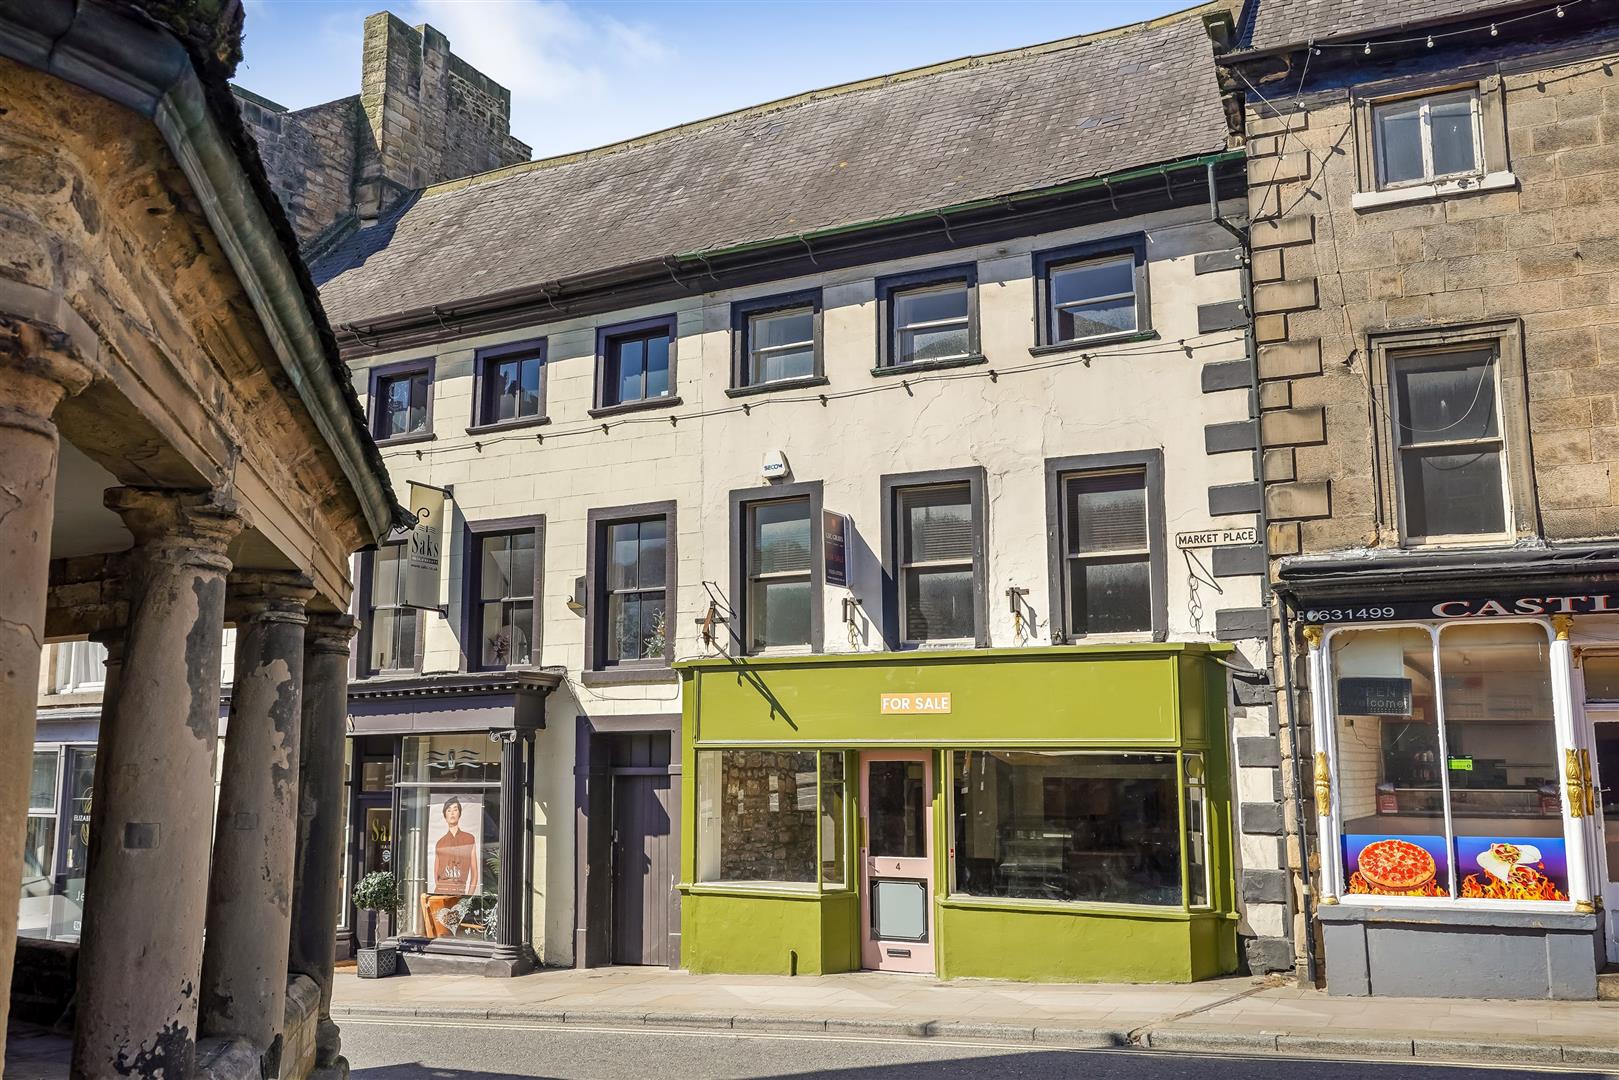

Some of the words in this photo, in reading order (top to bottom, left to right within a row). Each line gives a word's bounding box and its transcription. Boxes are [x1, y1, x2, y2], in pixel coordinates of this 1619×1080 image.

[763, 463, 783, 471] SECOM
[411, 531, 439, 558] Saks
[1178, 533, 1218, 545] MARKET
[1223, 531, 1254, 542] PLACE
[882, 697, 911, 711] FOR
[914, 697, 949, 710] SALE
[371, 819, 391, 842] Sa
[445, 865, 461, 879] Saks
[895, 862, 901, 871] 4
